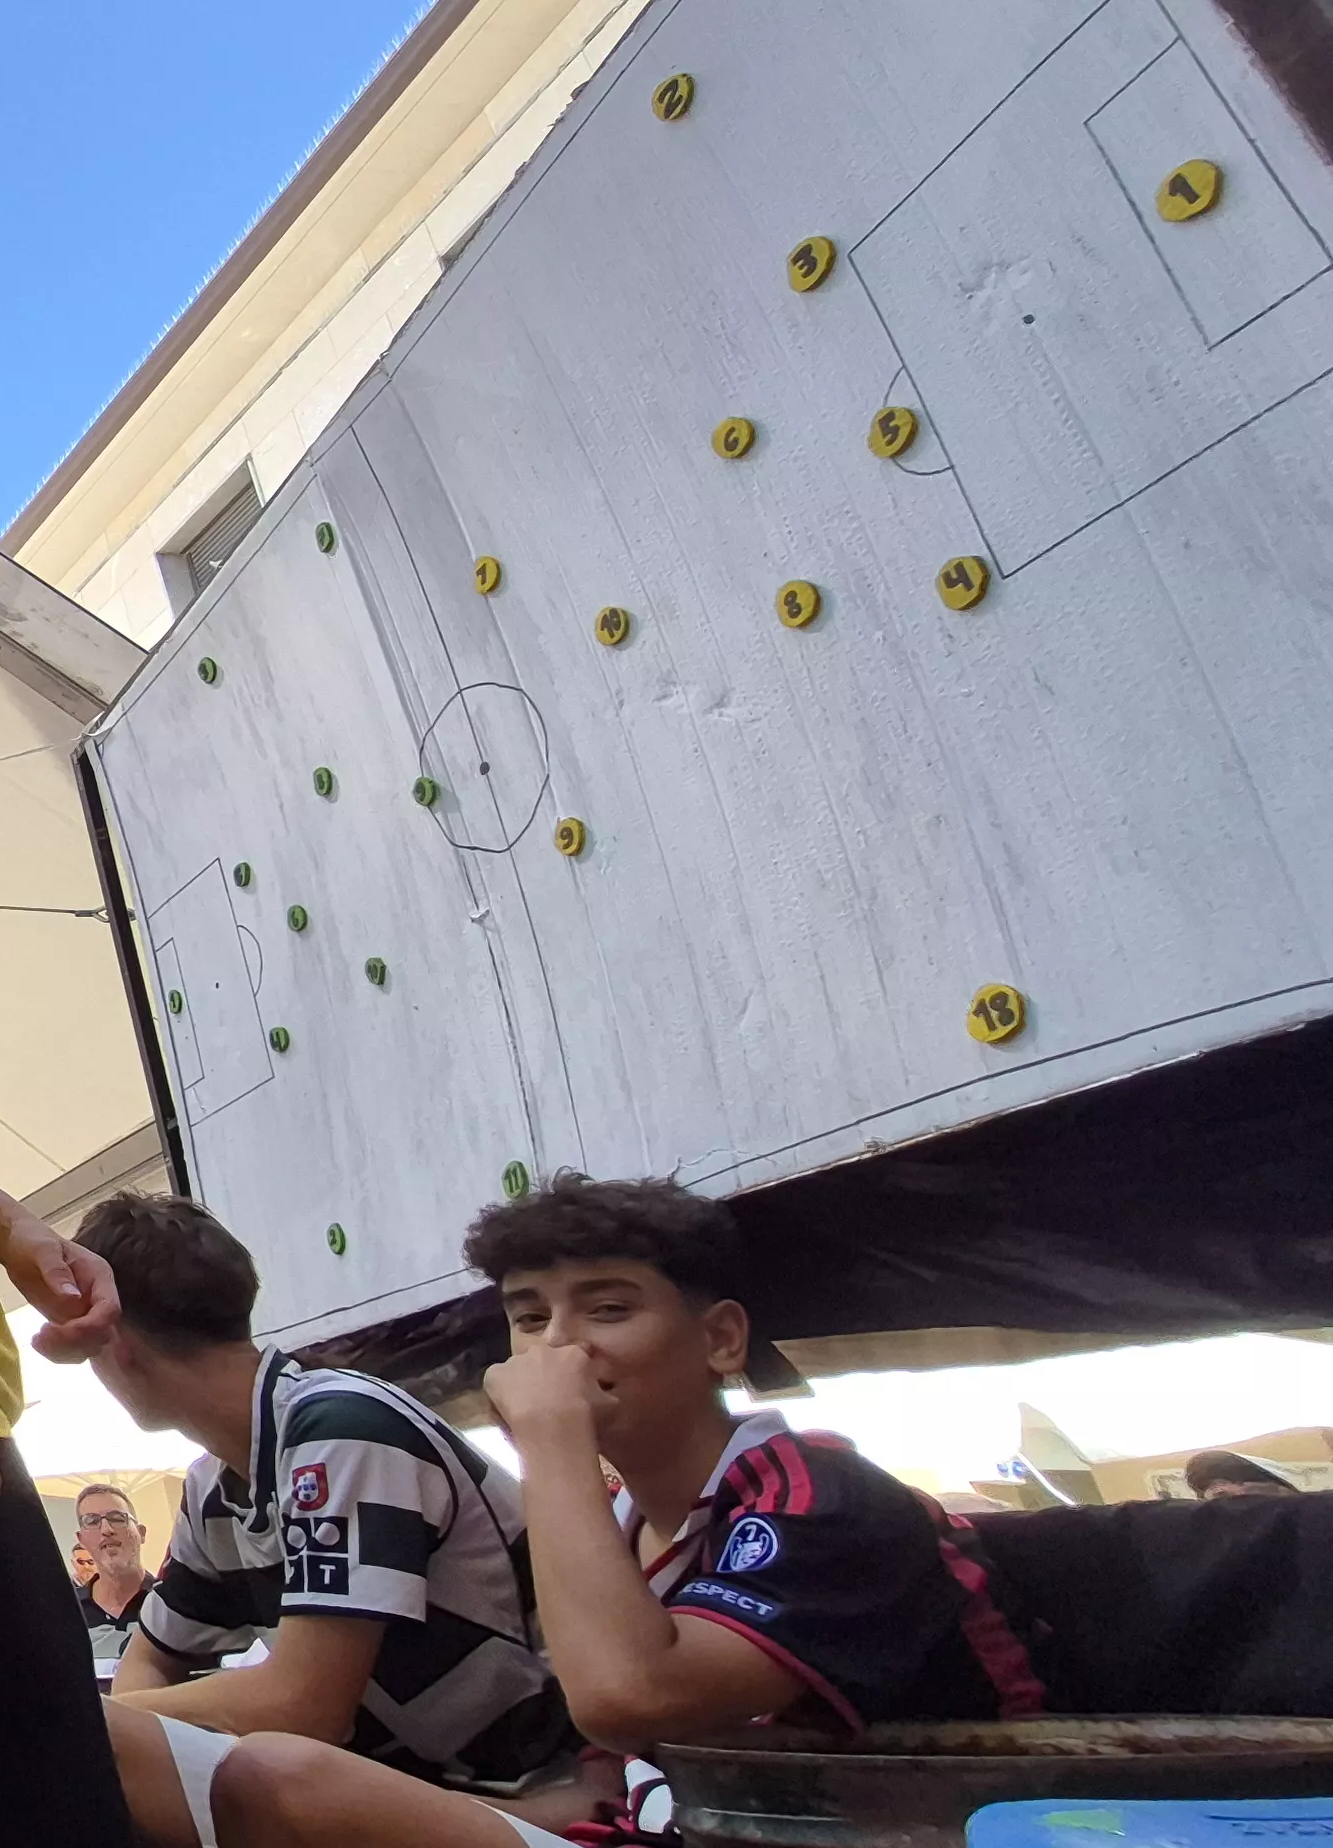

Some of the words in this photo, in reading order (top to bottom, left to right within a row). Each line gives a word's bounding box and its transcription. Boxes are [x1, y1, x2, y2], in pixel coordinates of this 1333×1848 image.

[656, 78, 683, 119] 2
[1168, 172, 1201, 205] 1
[790, 244, 818, 279] 3
[724, 426, 741, 452] 6
[878, 410, 901, 447] 5
[941, 560, 975, 592] 4
[784, 590, 802, 619] 8
[560, 827, 574, 850] 9
[681, 1582, 773, 1616] ESPECT
